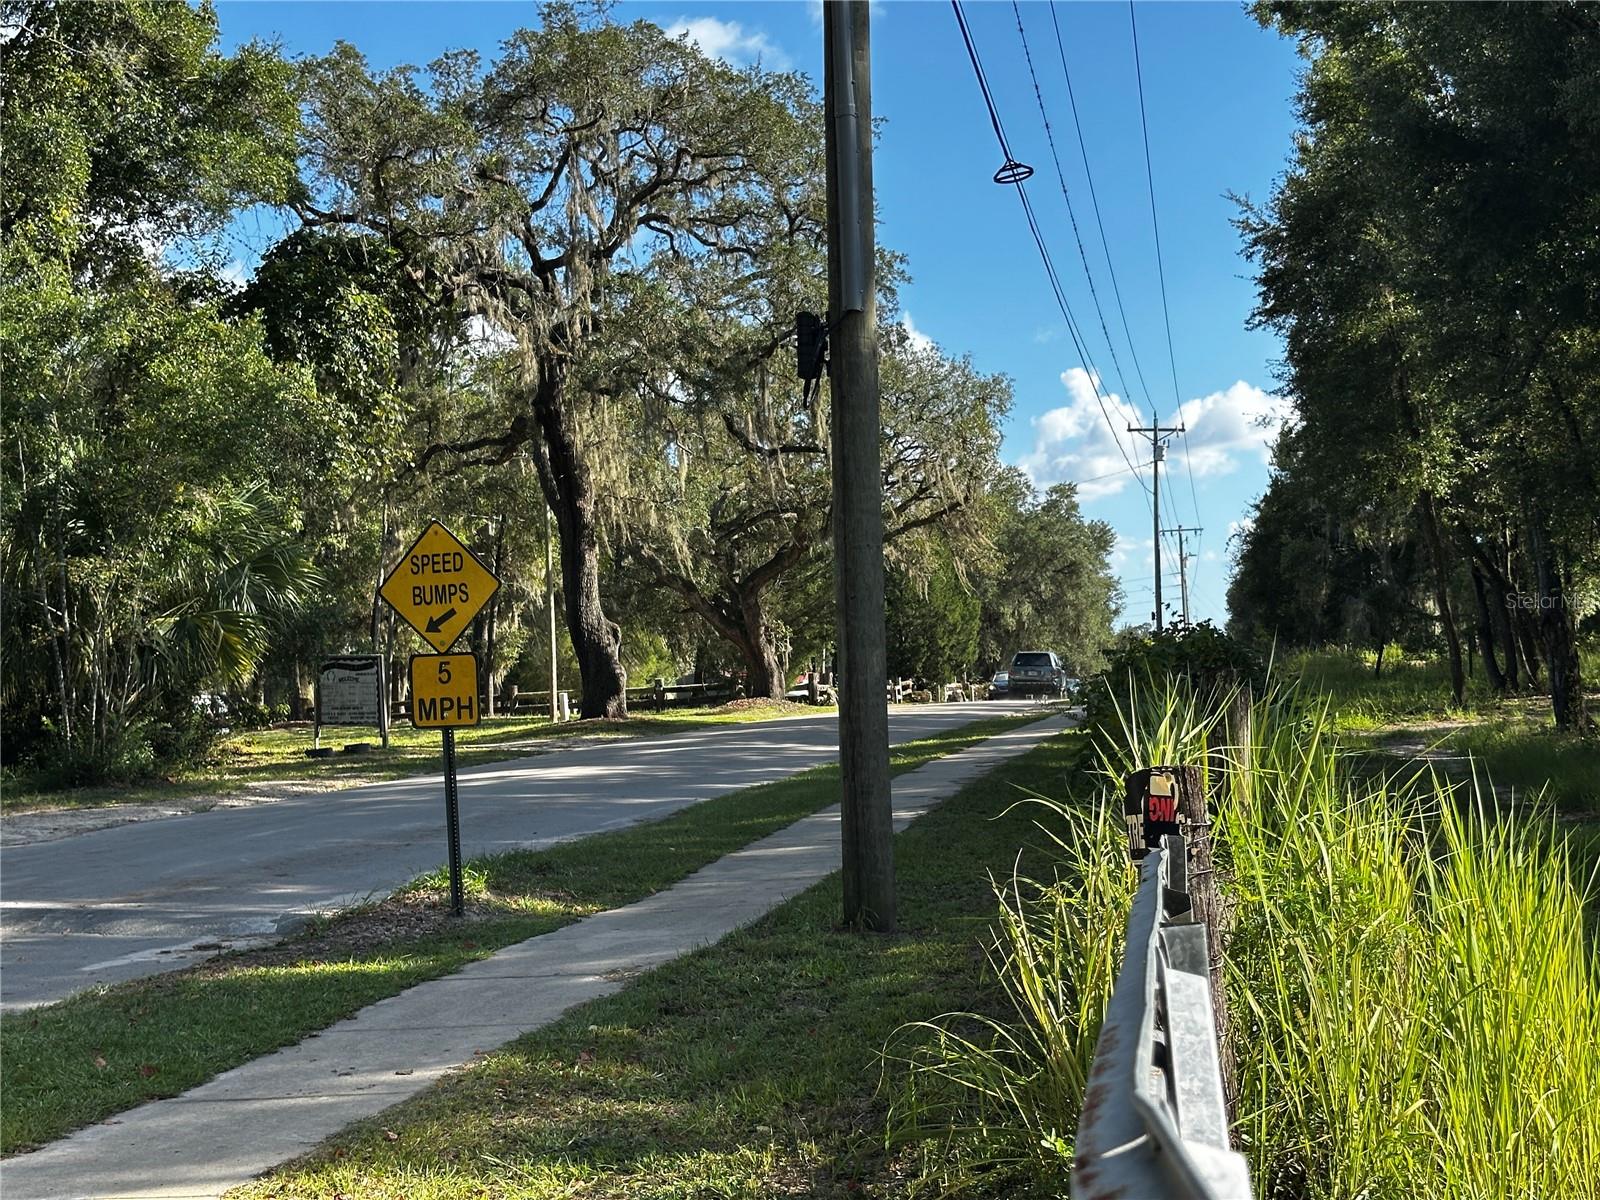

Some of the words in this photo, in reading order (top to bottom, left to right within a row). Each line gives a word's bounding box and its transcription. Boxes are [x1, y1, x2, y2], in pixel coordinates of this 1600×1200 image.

[410, 552, 464, 575] SPEED
[412, 583, 469, 606] BUMPS
[438, 661, 451, 685] 5
[418, 696, 473, 722] MPH
